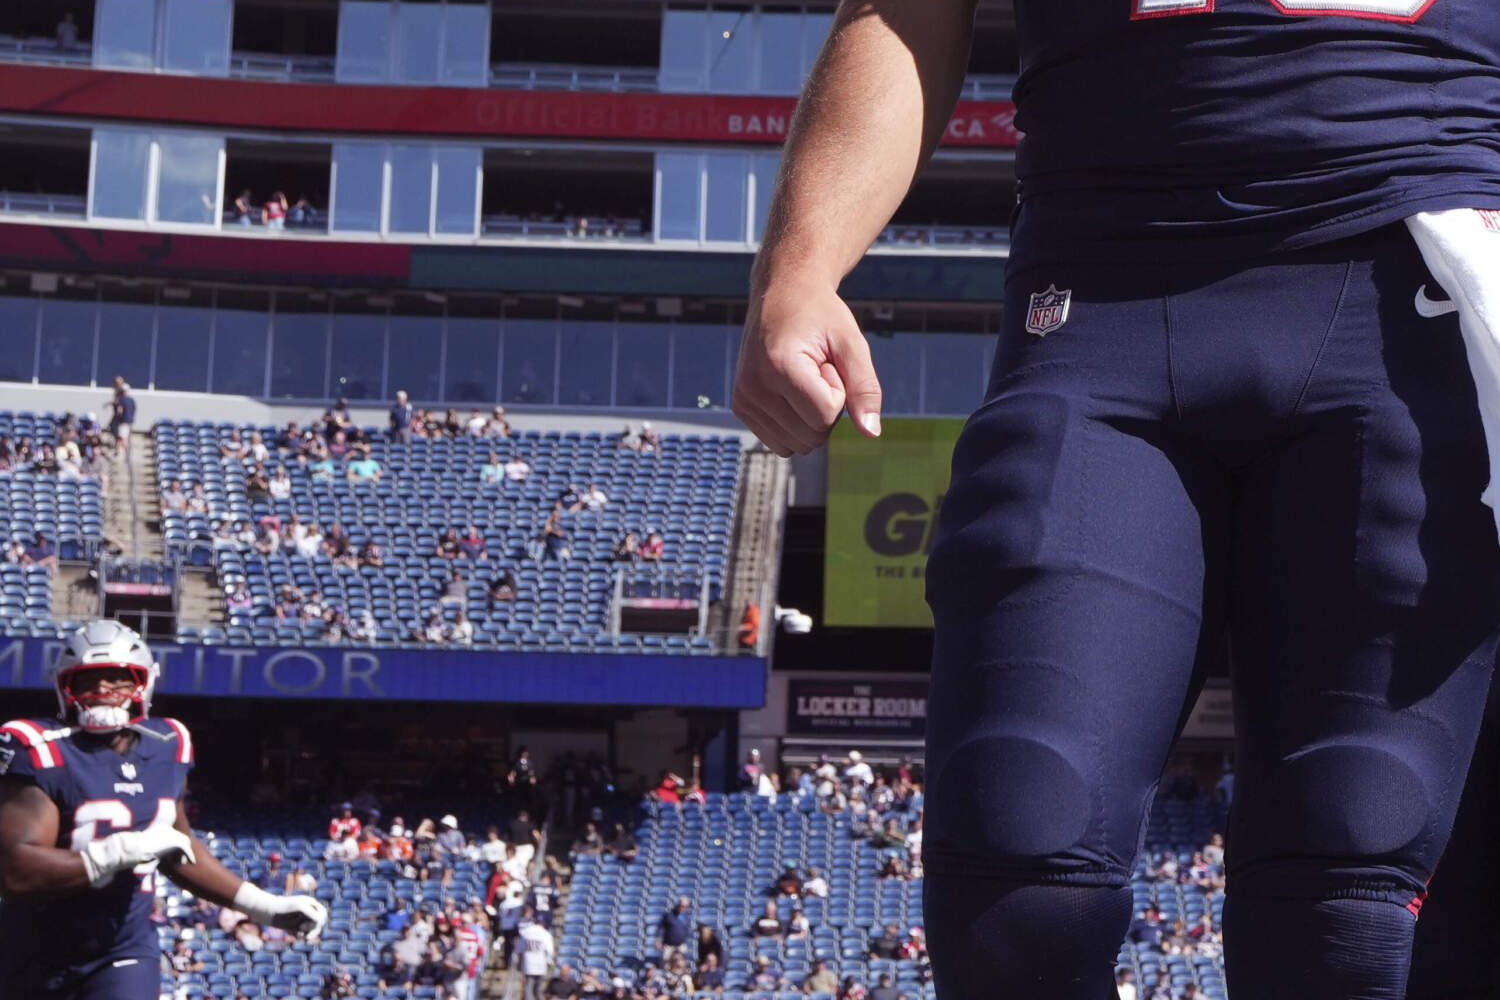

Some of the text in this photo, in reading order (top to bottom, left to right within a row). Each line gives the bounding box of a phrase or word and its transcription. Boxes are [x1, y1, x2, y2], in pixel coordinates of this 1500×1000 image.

[728, 114, 784, 134] BAN
[1031, 307, 1059, 327] NFL
[797, 696, 926, 718] LOCKER ROOM
